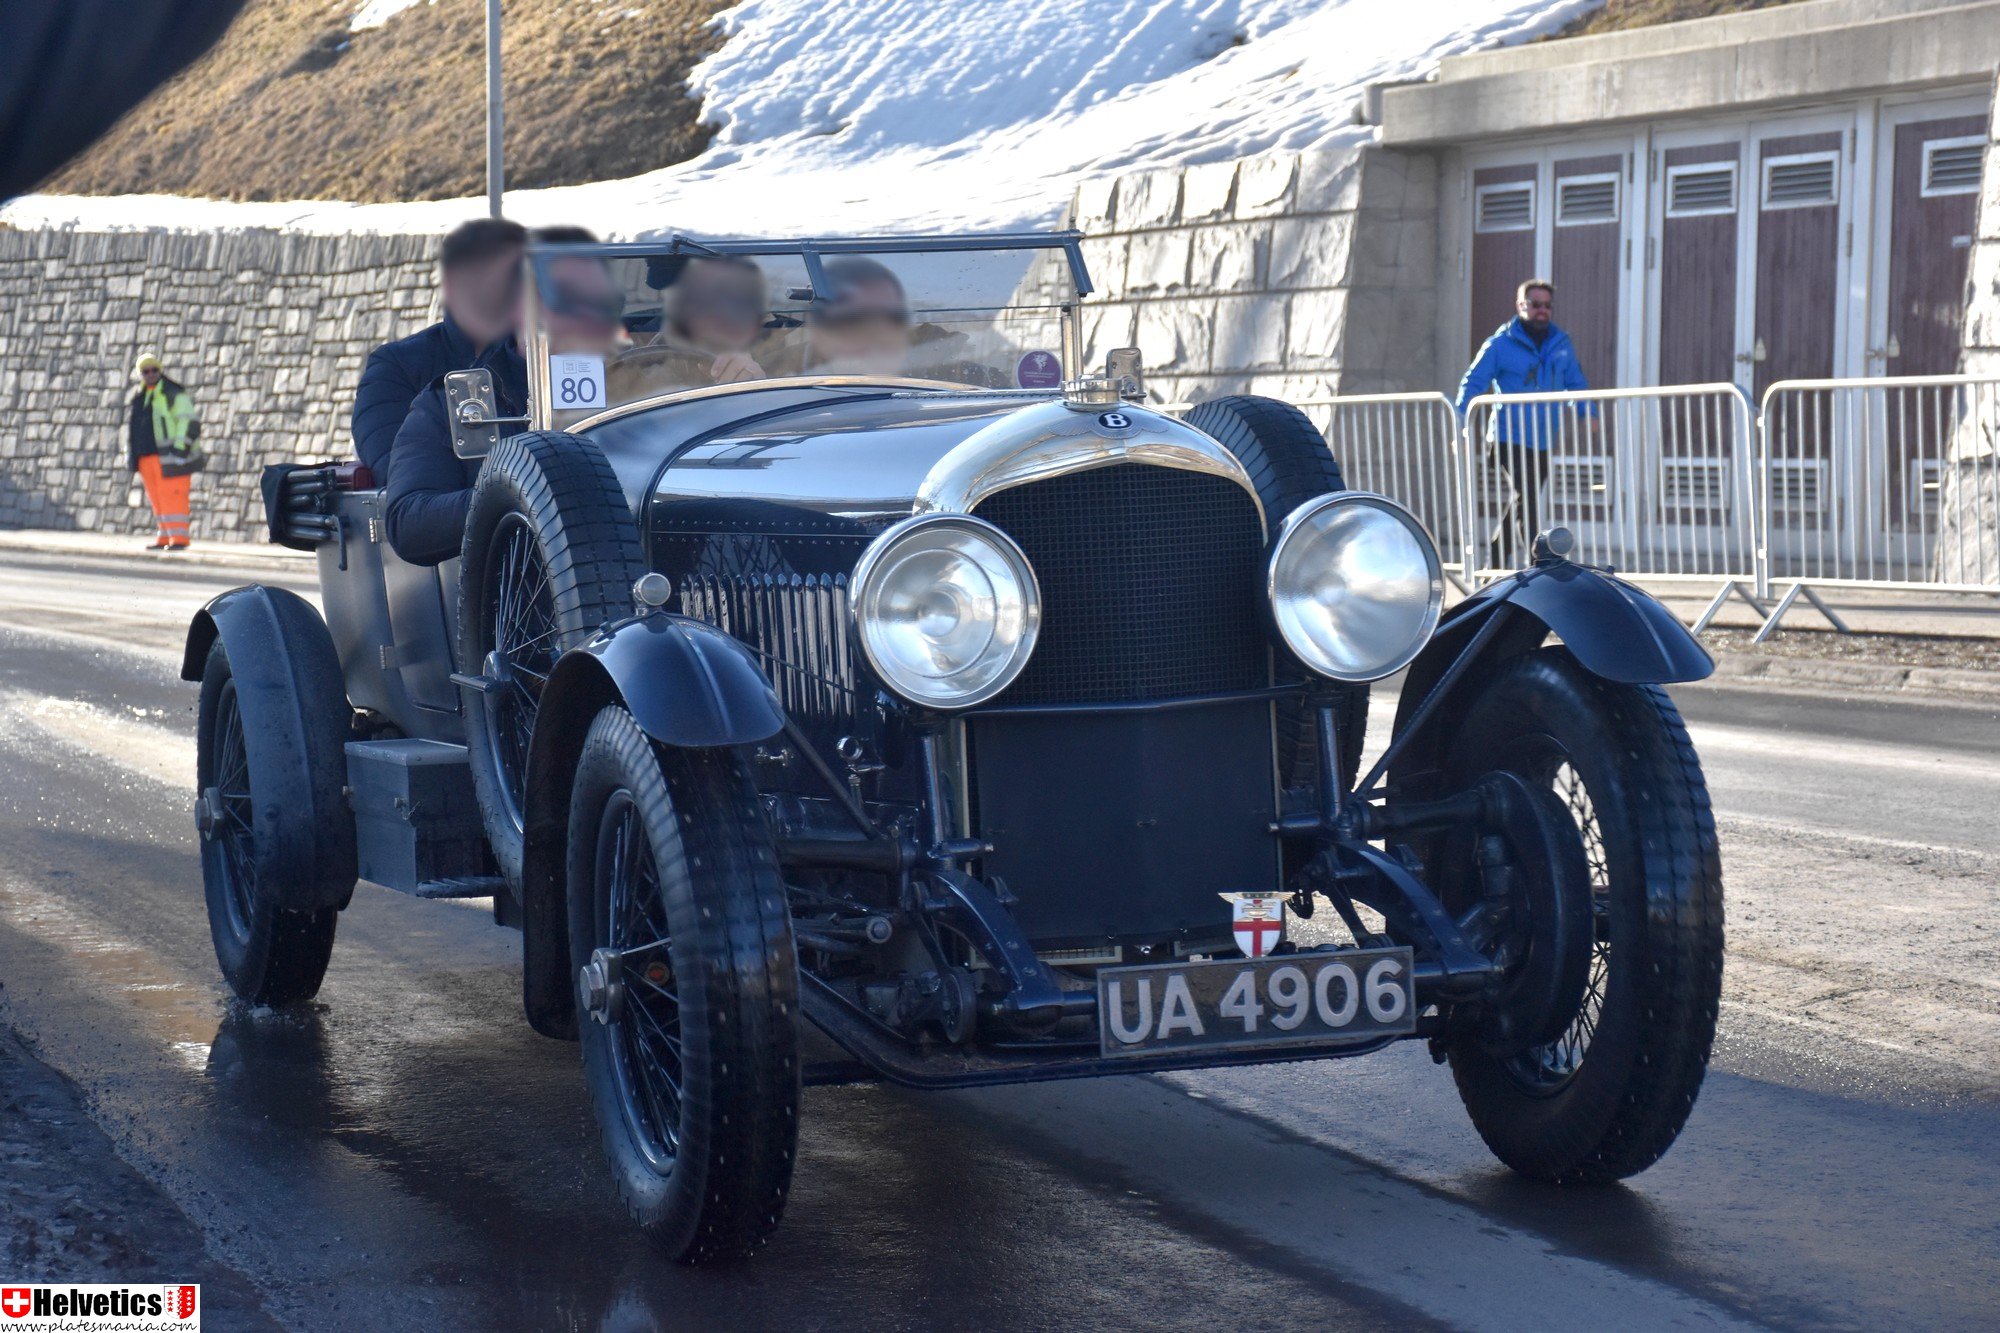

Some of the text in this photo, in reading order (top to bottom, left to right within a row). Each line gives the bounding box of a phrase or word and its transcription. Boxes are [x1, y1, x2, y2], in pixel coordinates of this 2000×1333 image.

[561, 377, 597, 403] 80
[1104, 413, 1128, 427] B
[1108, 959, 1407, 1044] UA 4906
